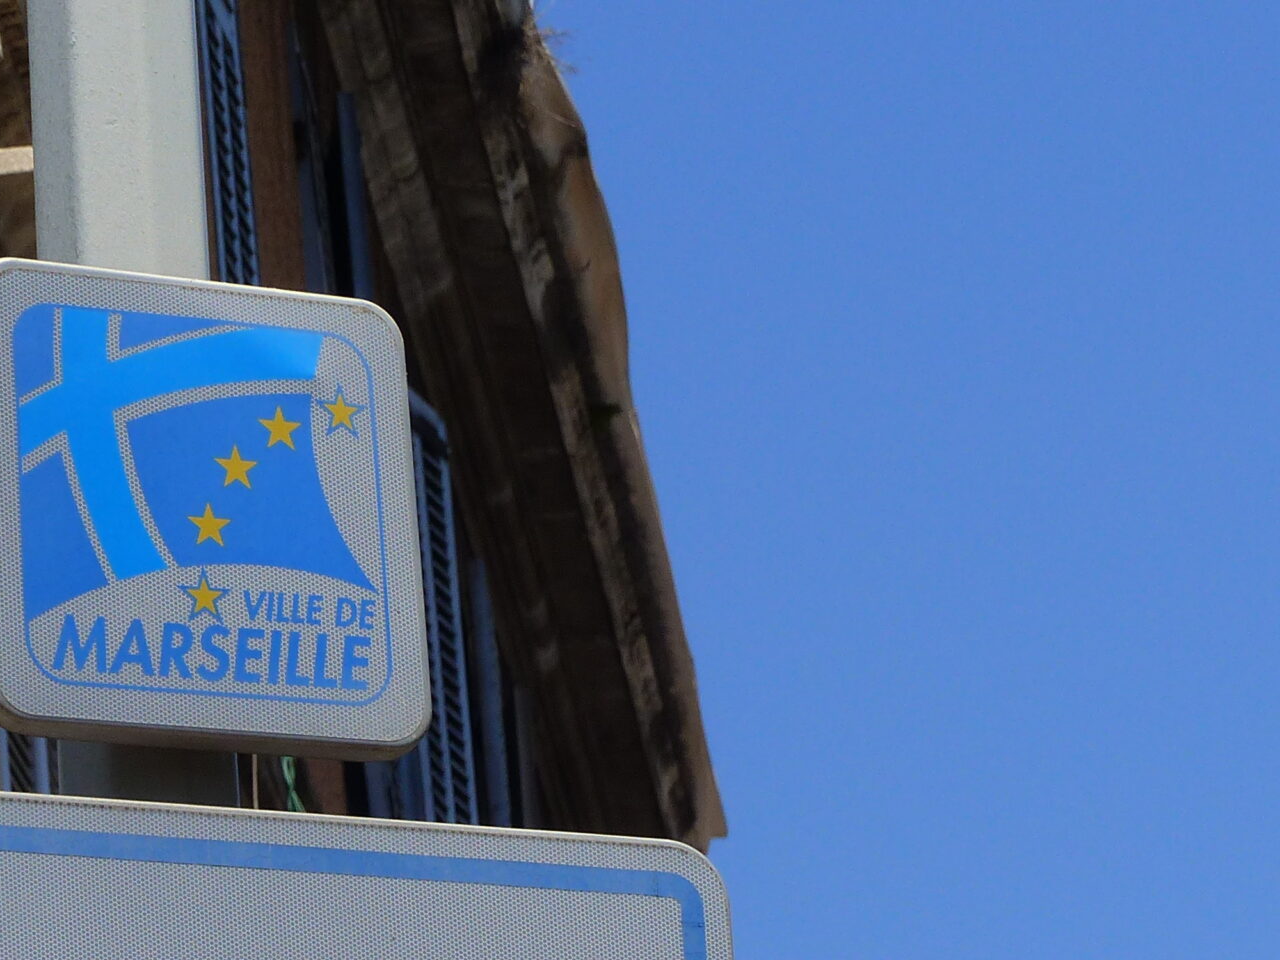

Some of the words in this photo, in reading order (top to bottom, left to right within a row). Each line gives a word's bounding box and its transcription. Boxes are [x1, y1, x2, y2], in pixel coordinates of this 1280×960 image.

[242, 589, 325, 626] VILLE
[335, 596, 376, 630] DE
[51, 613, 373, 691] MARSEILLE
